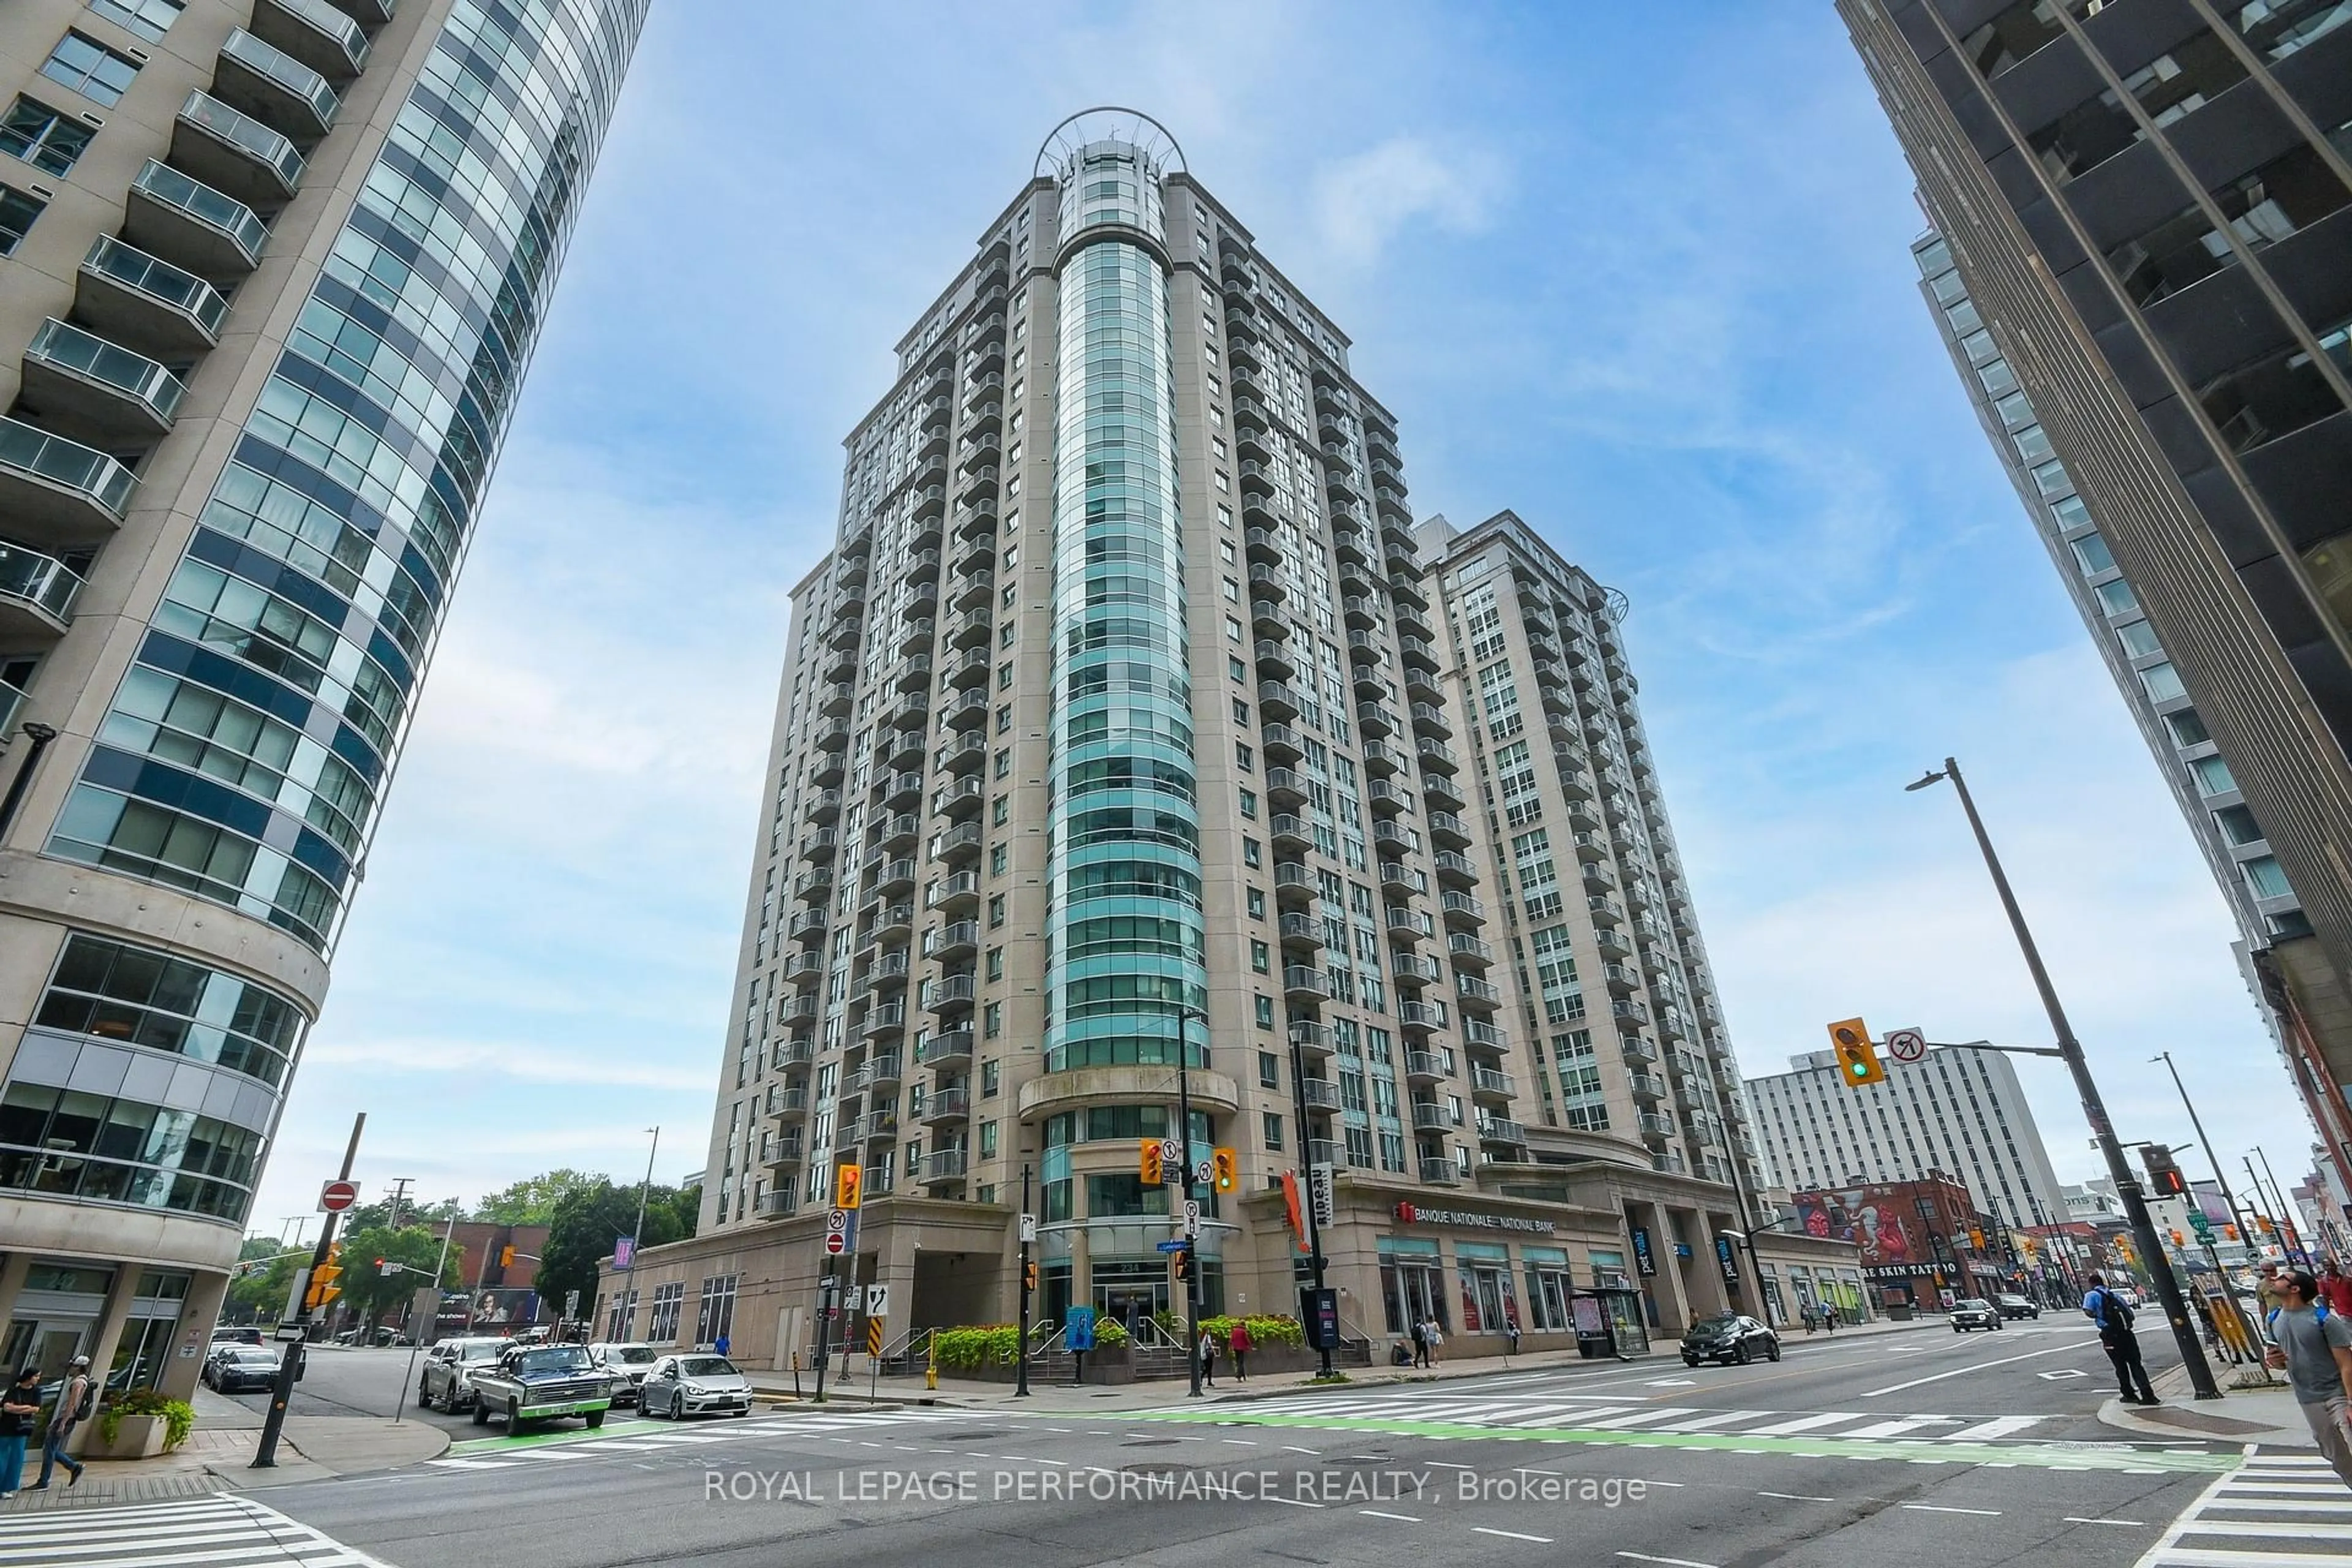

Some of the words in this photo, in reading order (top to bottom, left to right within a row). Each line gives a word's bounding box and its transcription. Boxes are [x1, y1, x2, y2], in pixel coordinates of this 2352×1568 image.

[1415, 1208, 1450, 1223] BANQUE
[1450, 1212, 1493, 1228] NATIONALE
[1500, 1216, 1534, 1232] NATIONAL
[1535, 1219, 1556, 1234] BANK
[1635, 1231, 1646, 1255] valu
[1639, 1255, 1654, 1274] pet
[1722, 1261, 1738, 1278] pet
[1879, 1265, 1907, 1276] SKIN
